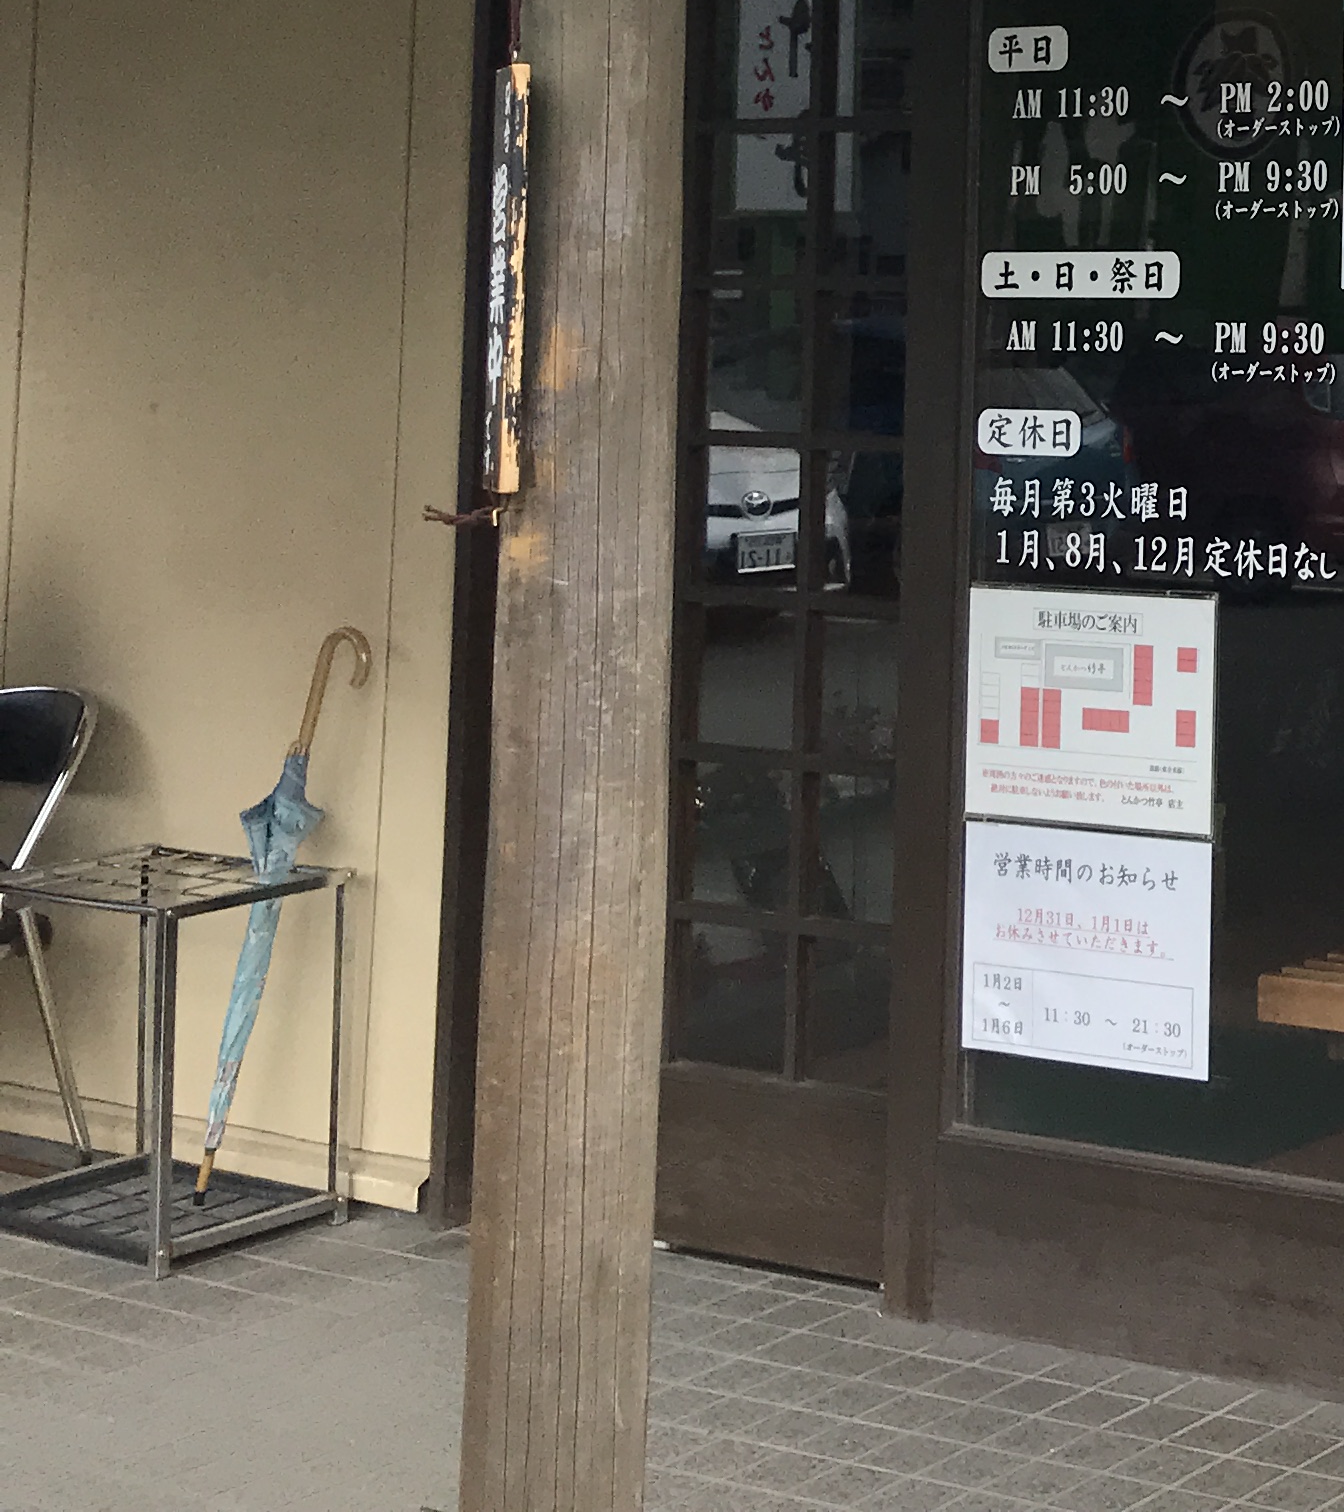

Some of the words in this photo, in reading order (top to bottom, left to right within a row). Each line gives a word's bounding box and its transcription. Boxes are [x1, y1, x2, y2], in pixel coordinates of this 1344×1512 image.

[997, 32, 1053, 68] 平日
[1012, 90, 1042, 119] AM
[1058, 86, 1129, 118] 11:30
[1219, 82, 1252, 114] PM
[1268, 80, 1329, 112] 2:00
[1217, 116, 1341, 139] (オーダーストップ)
[1010, 166, 1041, 196] PM
[1069, 164, 1127, 194] 5:00
[1218, 161, 1251, 193] PM
[1266, 159, 1328, 191] 9:30
[1215, 199, 1339, 220] (オーダーストップ)
[993, 258, 1165, 293] 土・日・祭日
[1006, 320, 1037, 351] AM
[1052, 320, 1124, 351] 11:30
[1214, 322, 1247, 354] PM
[1262, 322, 1325, 355] 9:30
[1211, 362, 1336, 384] (オーダーストップ)
[987, 413, 1073, 452] 定休日
[989, 476, 1188, 523] 毎月第3火曜日
[996, 529, 1337, 581] 1月、8月、12月定休日なし
[1037, 610, 1138, 635] 駐車場のご案内
[993, 852, 1179, 892] 営業時間のお知らせ
[1017, 908, 1149, 936] 12月31日、1月1日は
[995, 924, 1167, 958] お休みさせていただきます。
[983, 973, 1023, 992] 1月2日
[981, 1018, 1024, 1036] 1月6日
